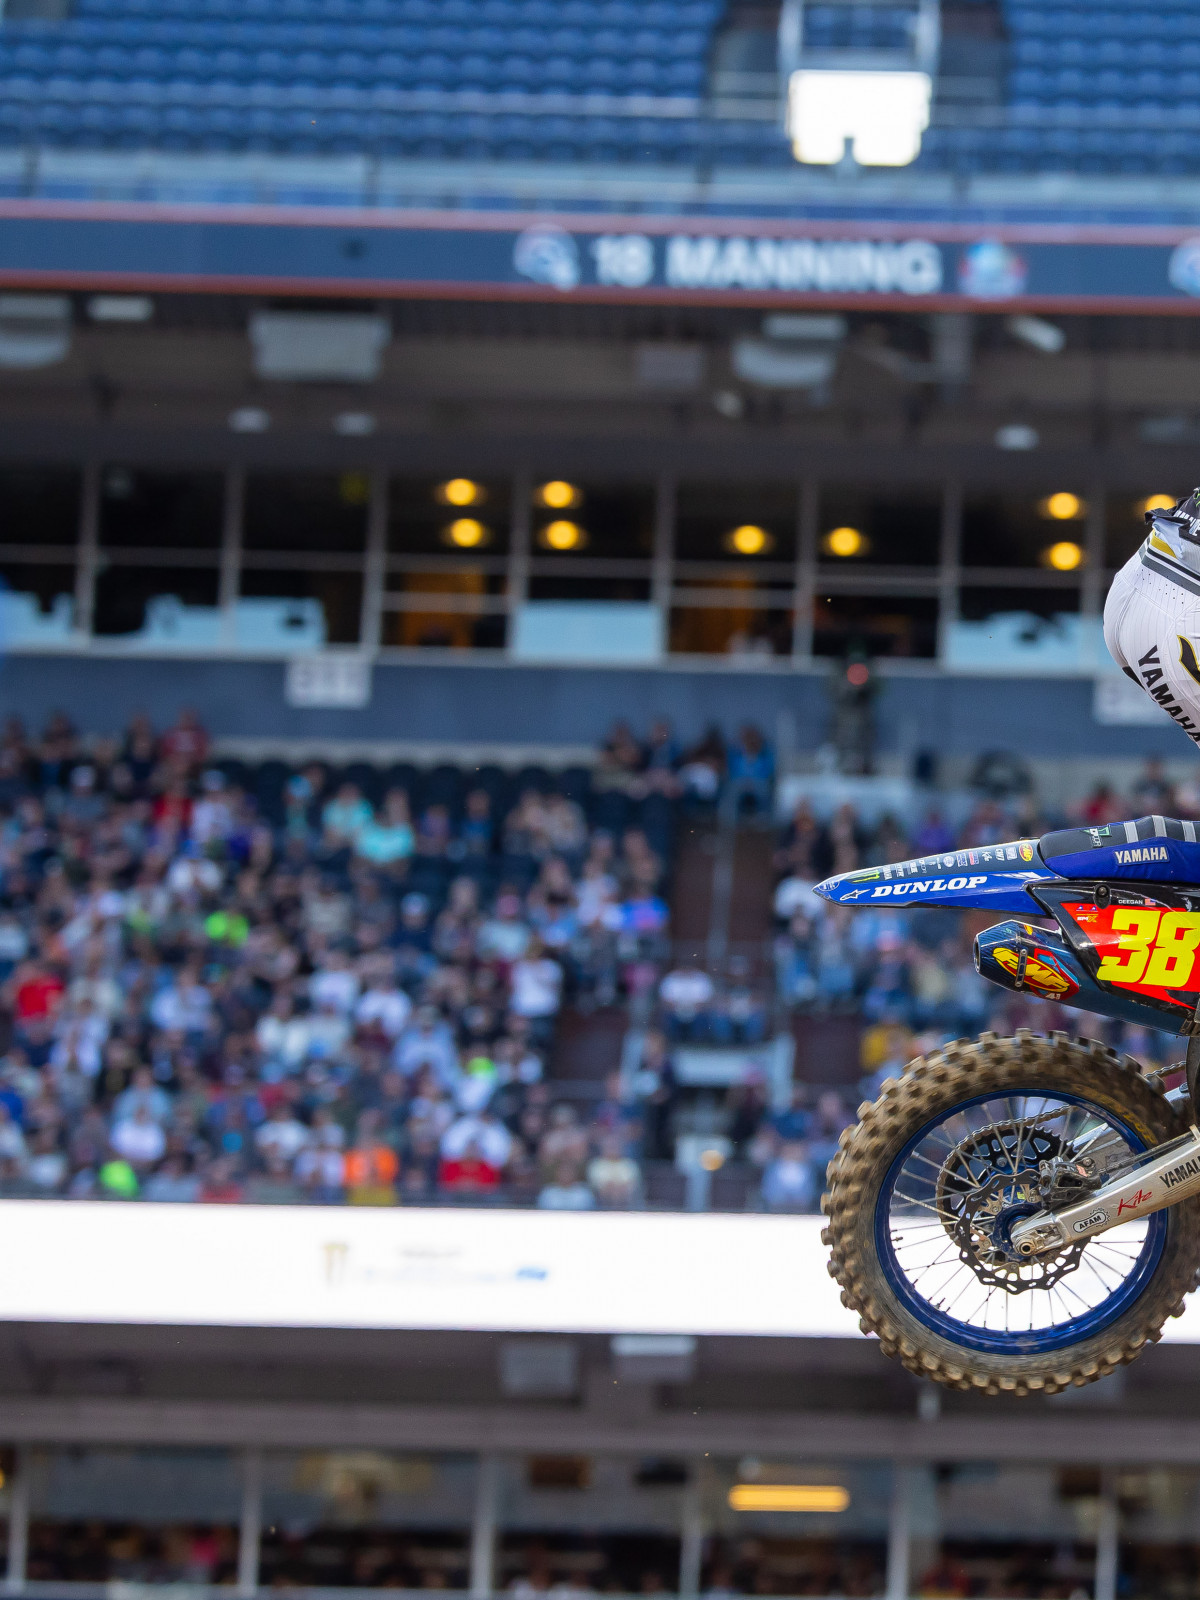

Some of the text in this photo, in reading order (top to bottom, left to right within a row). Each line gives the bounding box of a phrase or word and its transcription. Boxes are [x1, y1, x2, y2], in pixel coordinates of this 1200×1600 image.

[665, 237, 942, 295] MANNING
[1115, 846, 1168, 864] YAMAHA
[870, 875, 988, 898] DUNLOP
[1079, 1215, 1102, 1230] AFAM
